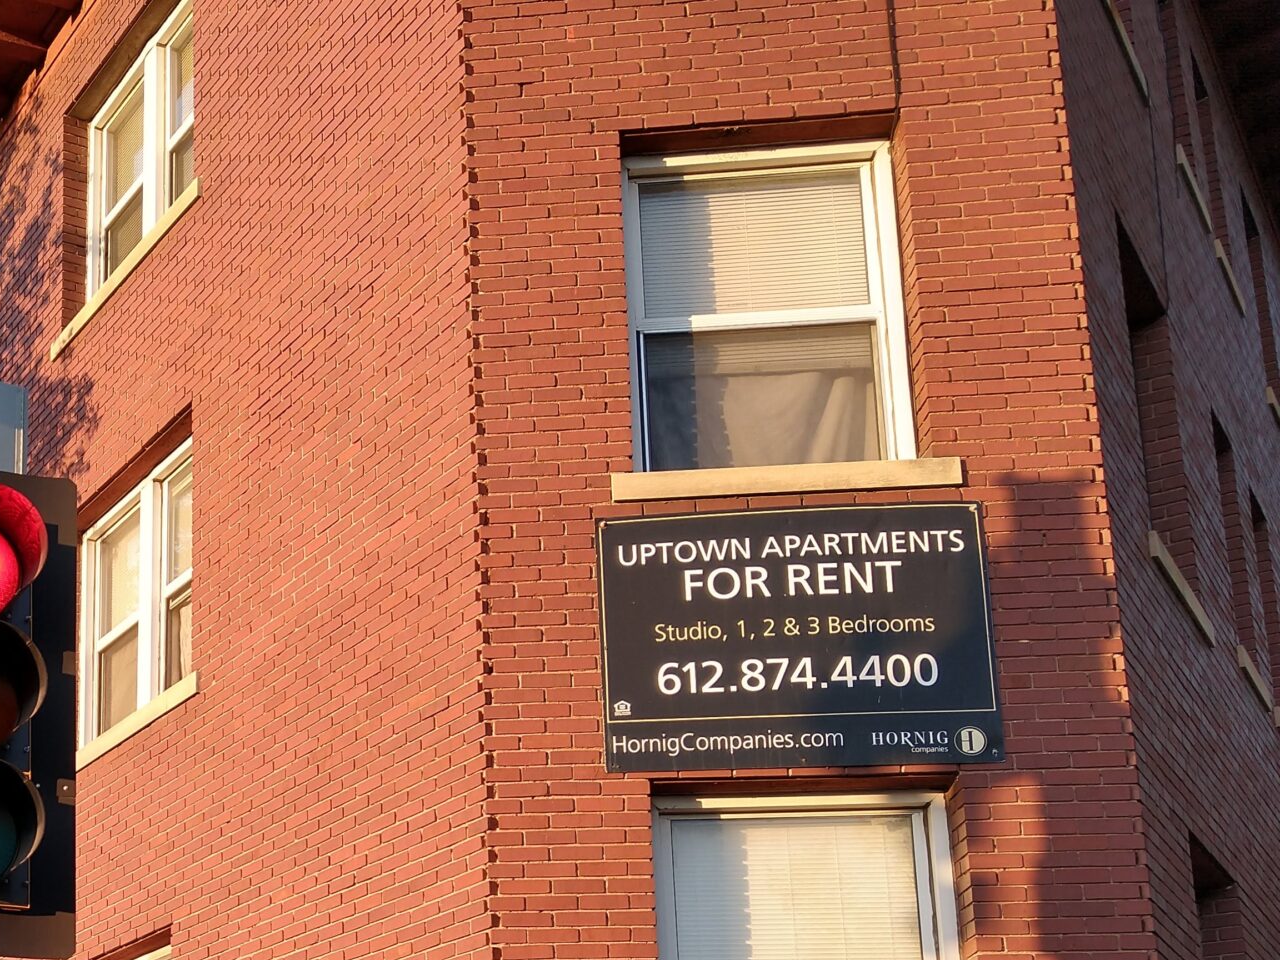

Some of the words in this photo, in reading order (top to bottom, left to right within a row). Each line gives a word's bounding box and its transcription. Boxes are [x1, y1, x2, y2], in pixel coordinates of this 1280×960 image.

[617, 537, 751, 567] UPTOWN
[761, 529, 965, 558] APARTMENTS
[683, 565, 772, 602] FOR
[787, 560, 902, 597] RENT
[654, 620, 728, 642] Studio,
[736, 620, 755, 641] 1,
[762, 618, 777, 637] 2
[783, 617, 801, 636] &
[807, 616, 821, 635] 3
[828, 613, 936, 635] Bedrooms
[656, 652, 939, 696] 612.874.4400
[612, 728, 845, 758] HornigCompanies.com
[871, 730, 949, 747] HORNIG
[911, 745, 949, 754] companies
